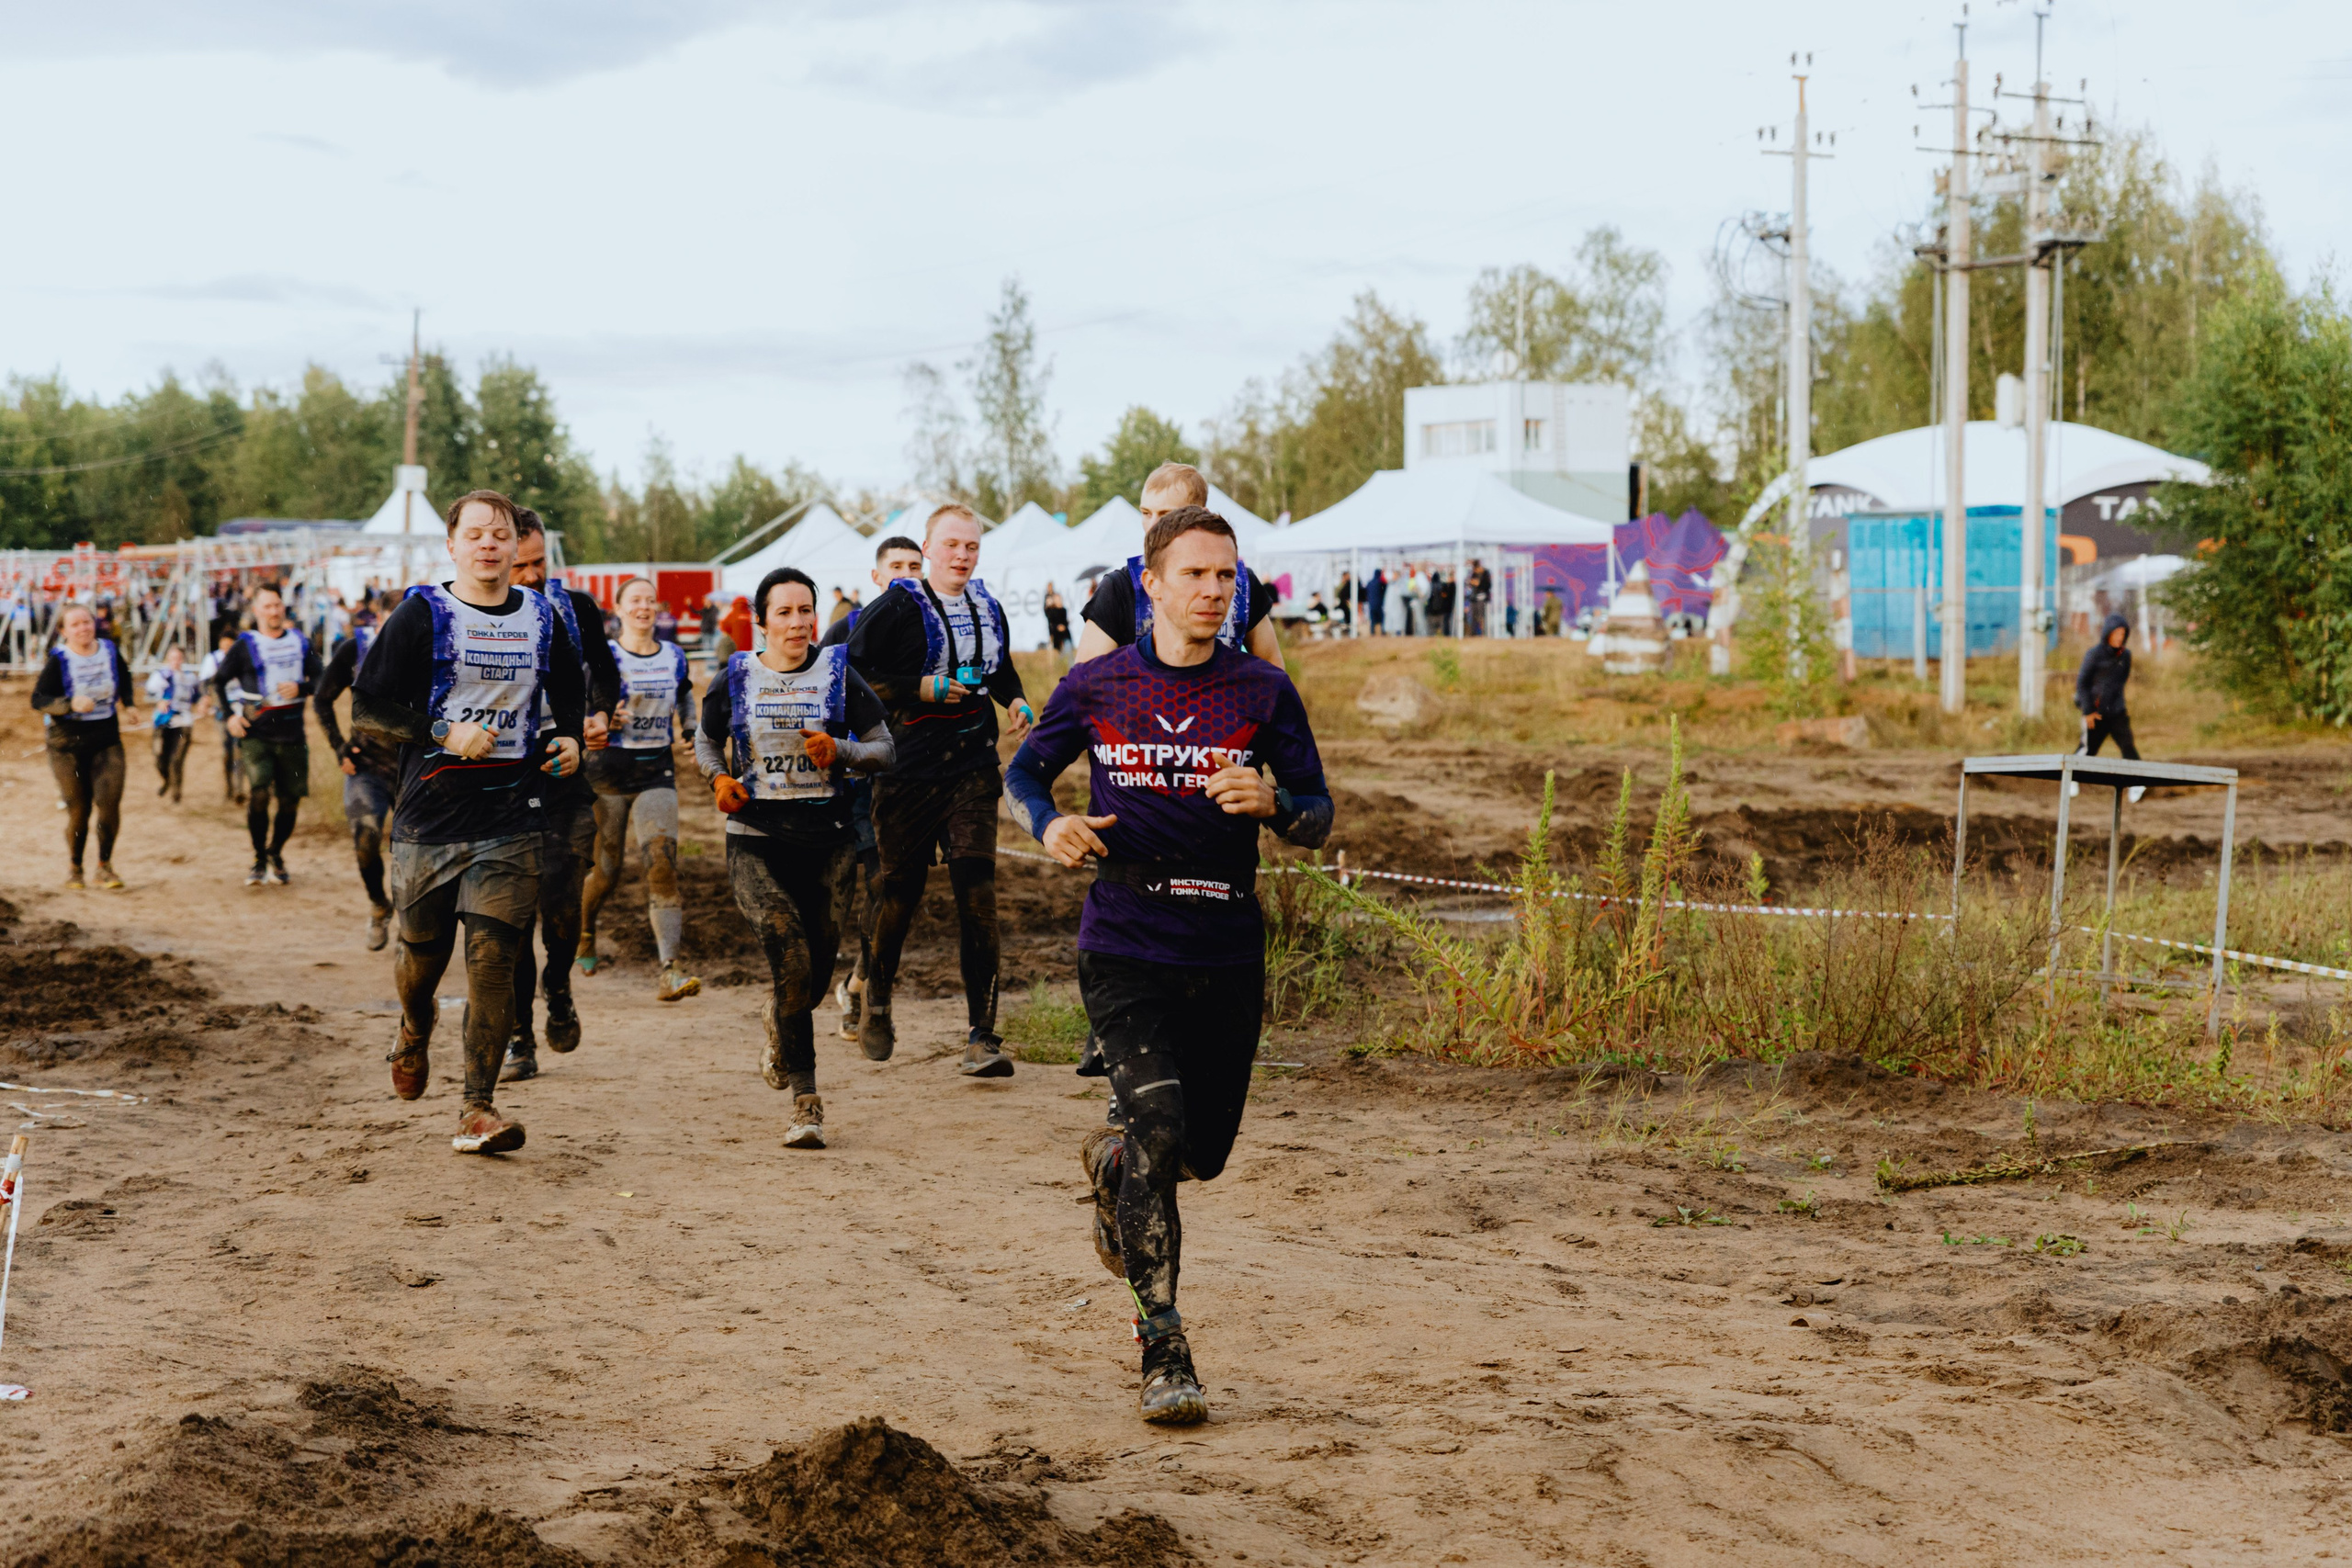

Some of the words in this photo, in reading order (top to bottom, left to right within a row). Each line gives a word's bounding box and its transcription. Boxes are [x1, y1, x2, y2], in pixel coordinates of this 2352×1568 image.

[467, 629, 495, 637] ГОНКА
[466, 651, 531, 668] КОМАНДНЫЙ
[482, 667, 514, 680] СТАРТ
[756, 704, 820, 716] КОМАНДНЫЙ
[460, 707, 518, 729] 22708
[774, 717, 803, 728] СТАРТ
[1094, 743, 1254, 768] ИНСТРУКТОР
[1108, 772, 1168, 787] ГОНКА
[1173, 773, 1209, 788] ГЕР
[1170, 878, 1230, 891] ИНСТРУКТОР
[1170, 887, 1200, 896] ГОНКА
[1201, 889, 1229, 900] ГЕРОЕВ
